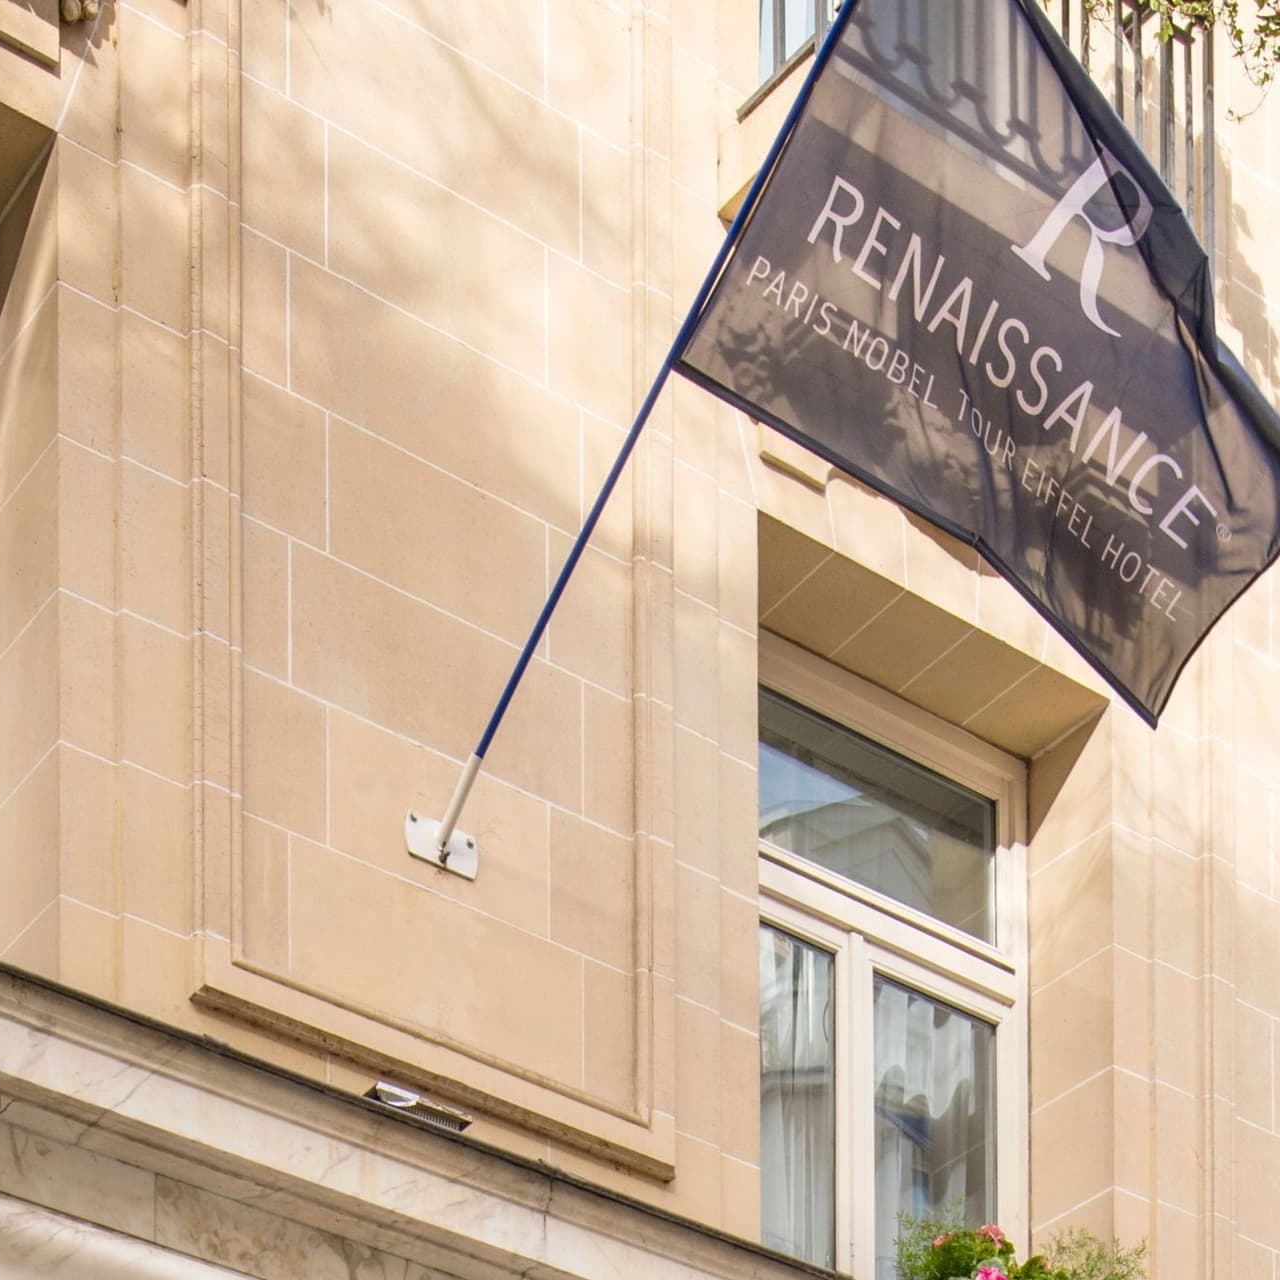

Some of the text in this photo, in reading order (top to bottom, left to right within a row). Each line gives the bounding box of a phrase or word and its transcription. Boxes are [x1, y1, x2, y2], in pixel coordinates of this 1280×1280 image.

[1012, 140, 1153, 338] R
[746, 255, 1186, 622] PARIS NOBEL TOUR EIFFEL HOTEL
